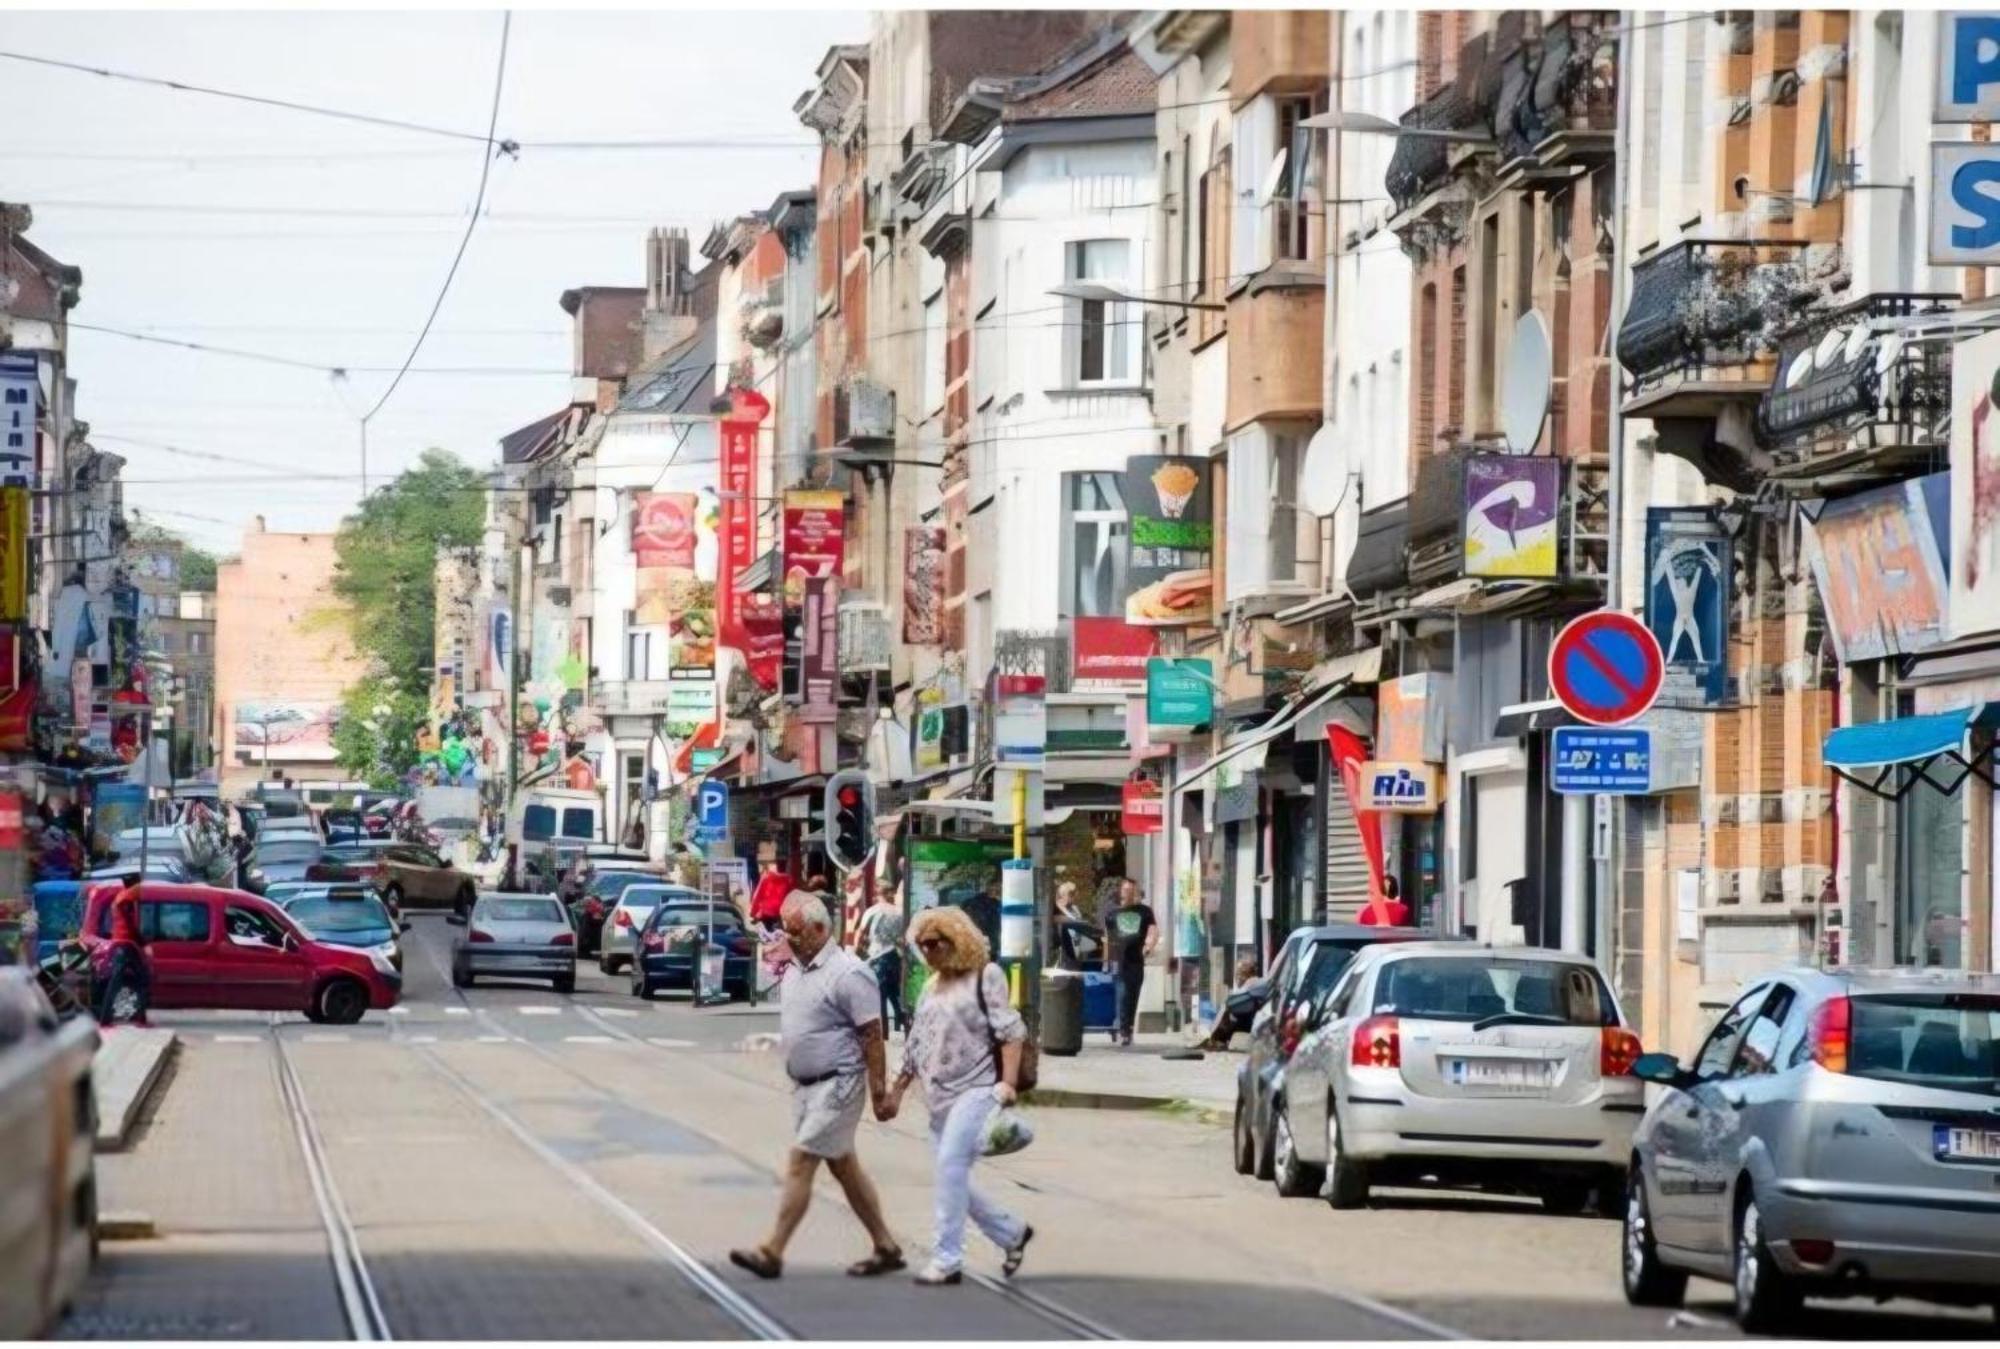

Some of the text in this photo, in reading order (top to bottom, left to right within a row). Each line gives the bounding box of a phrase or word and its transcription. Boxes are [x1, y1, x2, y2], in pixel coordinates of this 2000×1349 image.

[1953, 17, 2000, 104] P
[1951, 160, 2000, 249] S
[702, 791, 723, 823] P
